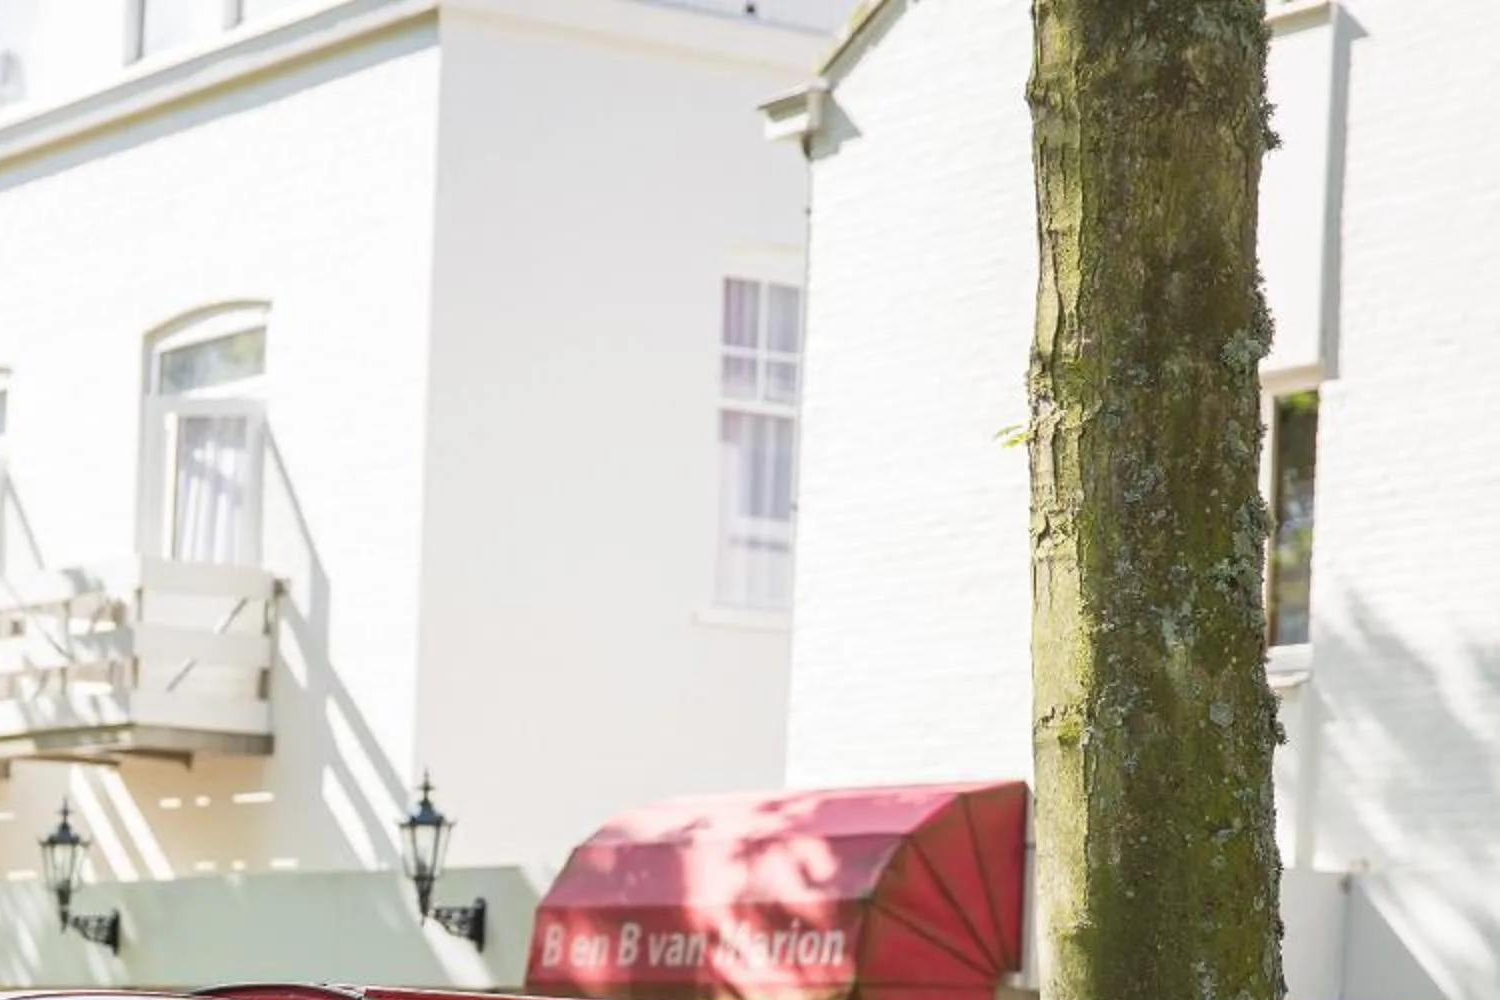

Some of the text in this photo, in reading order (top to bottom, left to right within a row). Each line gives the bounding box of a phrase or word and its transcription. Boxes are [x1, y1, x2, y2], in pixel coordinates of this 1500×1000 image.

[542, 918, 846, 967] B en B van Marion
